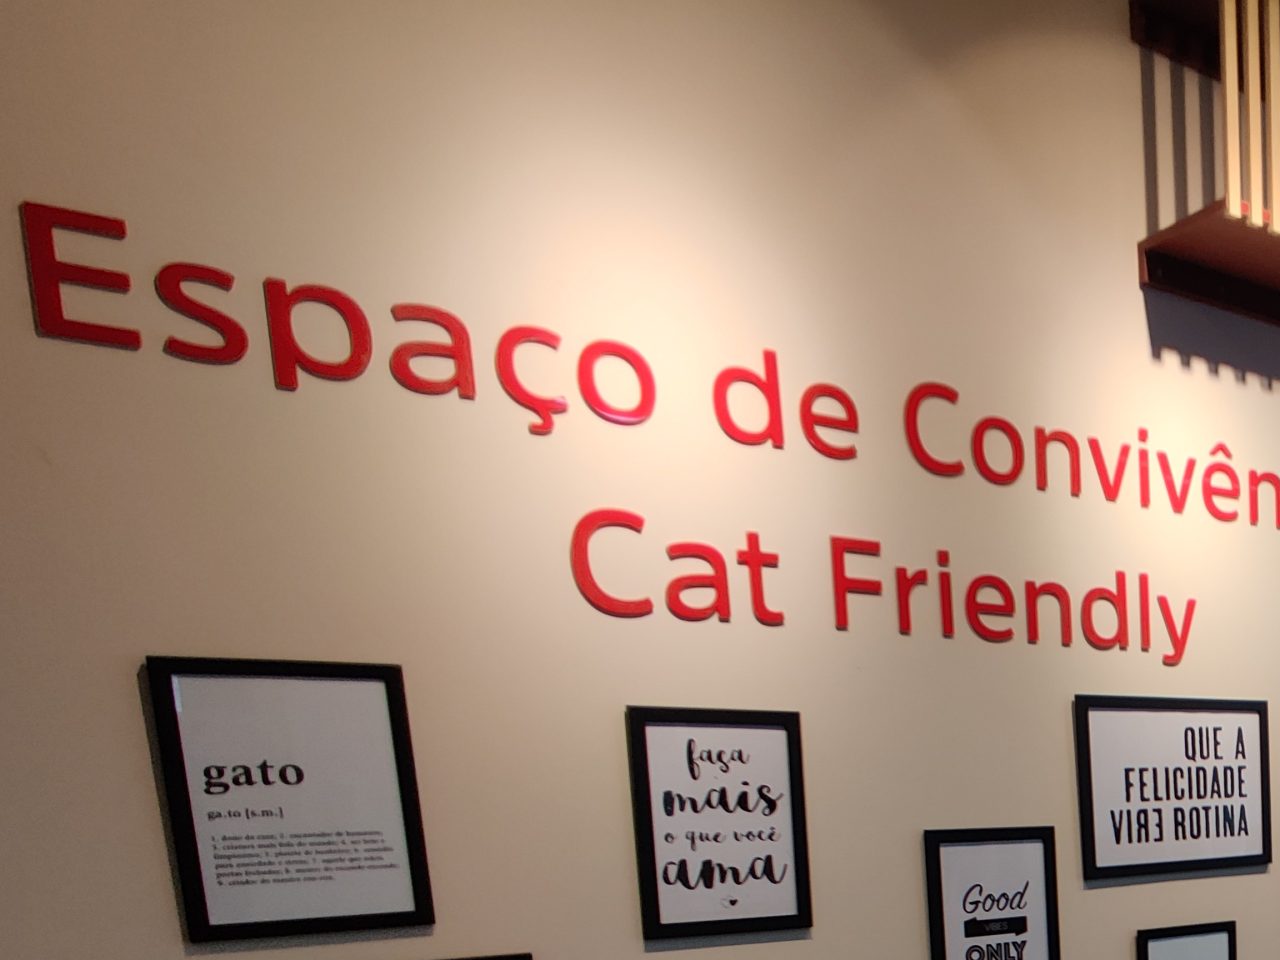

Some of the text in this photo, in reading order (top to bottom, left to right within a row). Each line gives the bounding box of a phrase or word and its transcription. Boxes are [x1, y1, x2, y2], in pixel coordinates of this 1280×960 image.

[19, 200, 657, 437] Espaço
[712, 349, 859, 460] de
[570, 507, 1197, 667] Cat Friendly
[686, 738, 750, 780] faça
[1184, 726, 1246, 762] QUE A
[203, 759, 305, 795] gato
[1124, 765, 1248, 803] FELICIDADE
[663, 781, 784, 816] mais
[664, 826, 782, 851] o que você
[1173, 804, 1249, 841] ROTINA
[662, 854, 788, 890] ama
[962, 880, 1030, 914] Good
